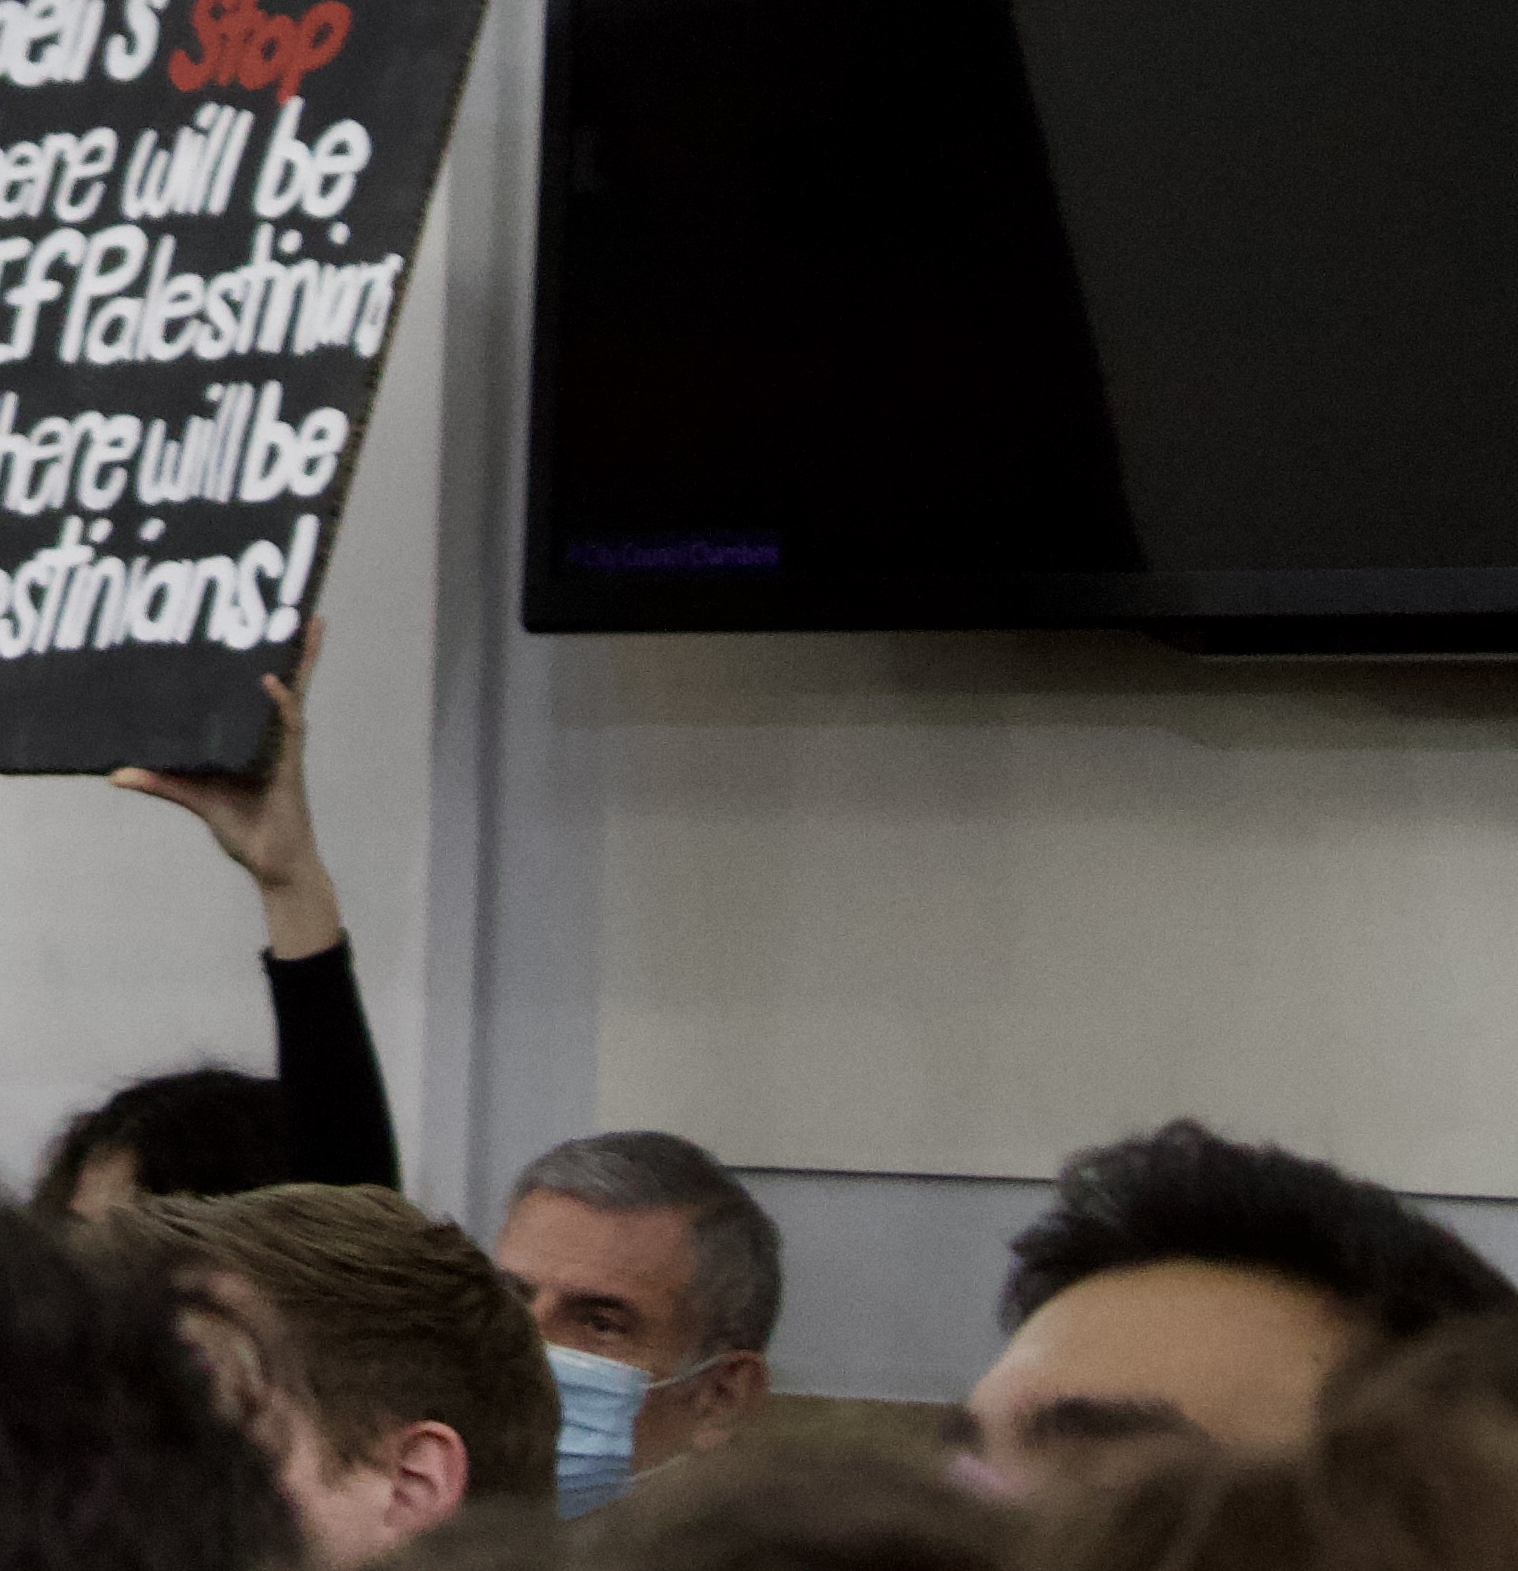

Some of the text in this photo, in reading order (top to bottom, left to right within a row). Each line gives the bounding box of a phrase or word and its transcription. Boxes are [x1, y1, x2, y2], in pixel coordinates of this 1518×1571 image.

[124, 100, 254, 223] will
[256, 95, 373, 220] be
[137, 380, 255, 505] will
[242, 379, 350, 504] be
